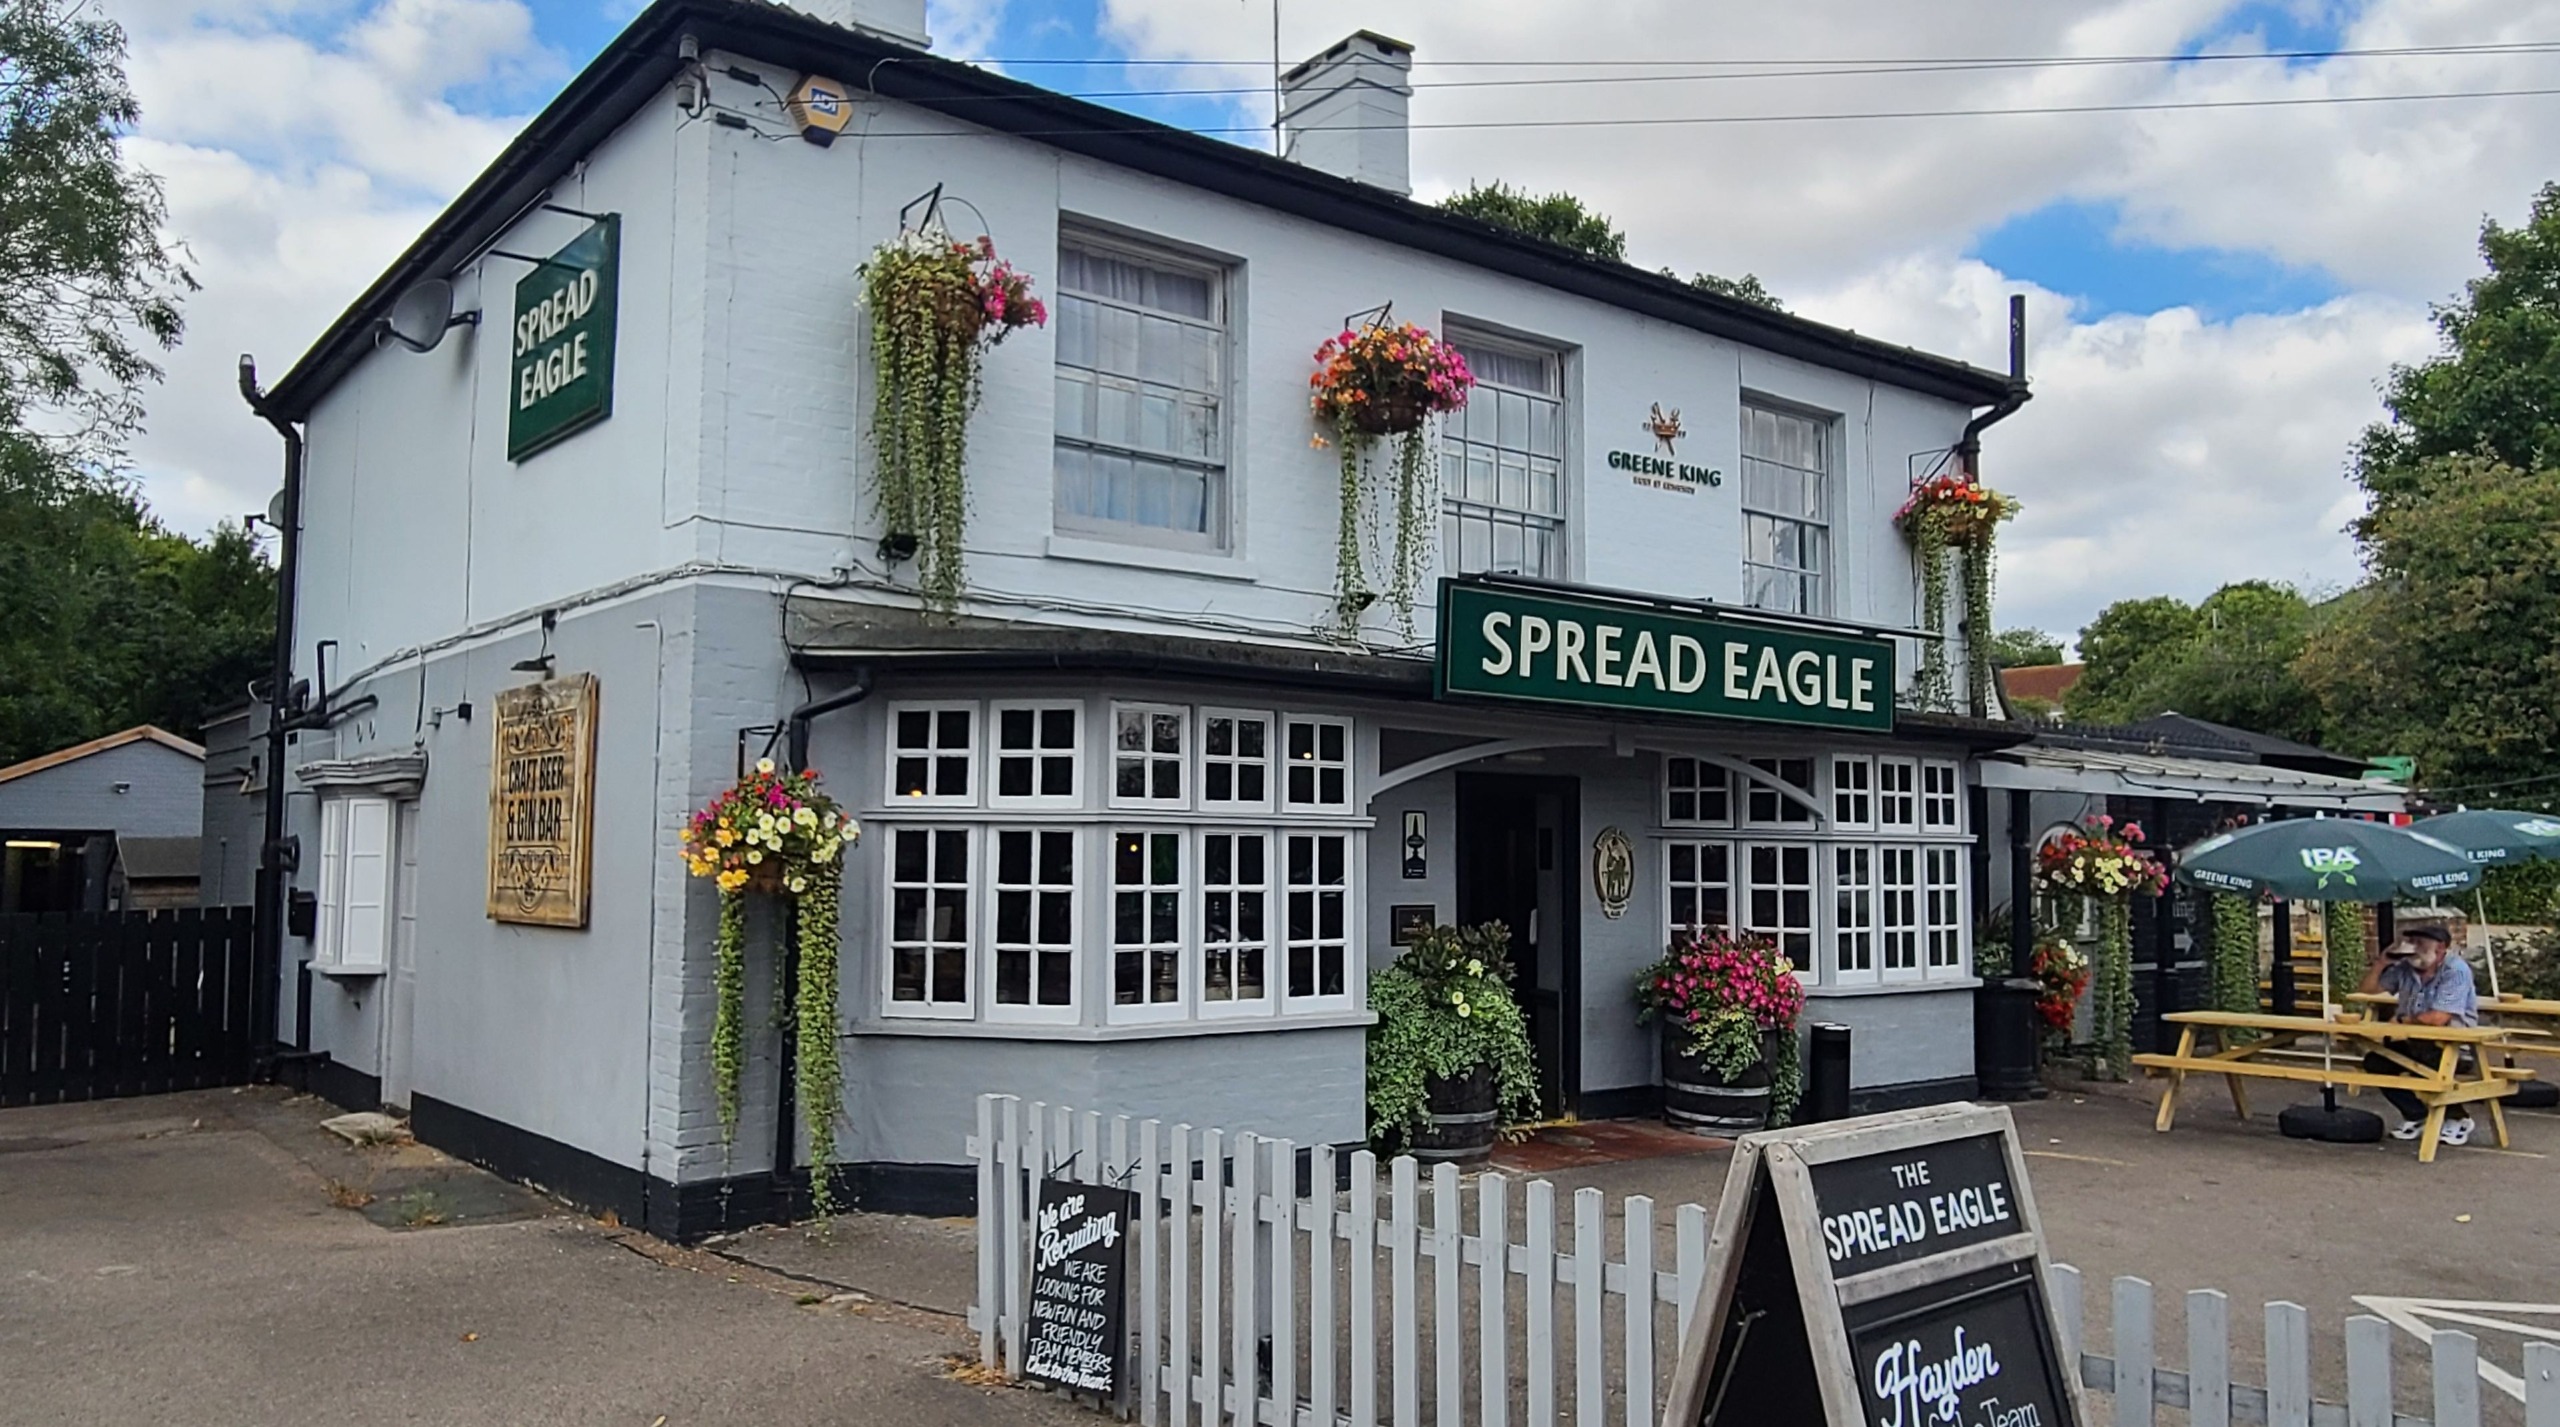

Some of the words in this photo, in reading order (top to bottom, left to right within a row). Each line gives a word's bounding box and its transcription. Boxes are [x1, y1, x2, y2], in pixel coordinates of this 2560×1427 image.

[516, 268, 598, 358] SPREAD
[520, 331, 588, 411] EAGLE
[1608, 450, 1675, 479] GREENE
[1679, 463, 1722, 487] KING
[1481, 611, 1707, 694] SPREAD
[1723, 641, 1875, 712] EAGLE
[508, 758, 538, 795] CRAFT
[539, 755, 565, 792] BEER
[507, 800, 515, 841] &
[517, 798, 536, 842] GIN
[538, 796, 563, 841] BAR
[2301, 846, 2362, 868] IPA
[2476, 848, 2507, 859] KING
[2194, 868, 2229, 885] GREENE
[2229, 875, 2253, 889] KING
[2411, 873, 2445, 888] GREENE
[2445, 871, 2469, 883] KING
[1891, 1160, 1931, 1189] THE
[1039, 1203, 1059, 1232] We
[1060, 1194, 1085, 1221] are
[1822, 1199, 1926, 1262] SPREAD
[1931, 1181, 2010, 1236] EAGLE
[1037, 1211, 1121, 1272] Recruiting
[1064, 1259, 1083, 1279] WE
[1081, 1260, 1108, 1284] ARE
[1035, 1275, 1080, 1303] LOOKING
[1081, 1285, 1106, 1307] FOR
[1032, 1299, 1057, 1320] NEW
[1055, 1304, 1077, 1326] FUN
[1078, 1308, 1106, 1331] AND
[1042, 1321, 1104, 1353] FRIENDLY
[1026, 1354, 1052, 1377] Chat
[1050, 1361, 1062, 1379] to
[1061, 1365, 1080, 1385] the
[1030, 1337, 1062, 1361] TEAM
[1062, 1344, 1112, 1373] MEMBERS
[1875, 1325, 2000, 1427] Hayden
[1979, 1397, 2042, 1427] Team
